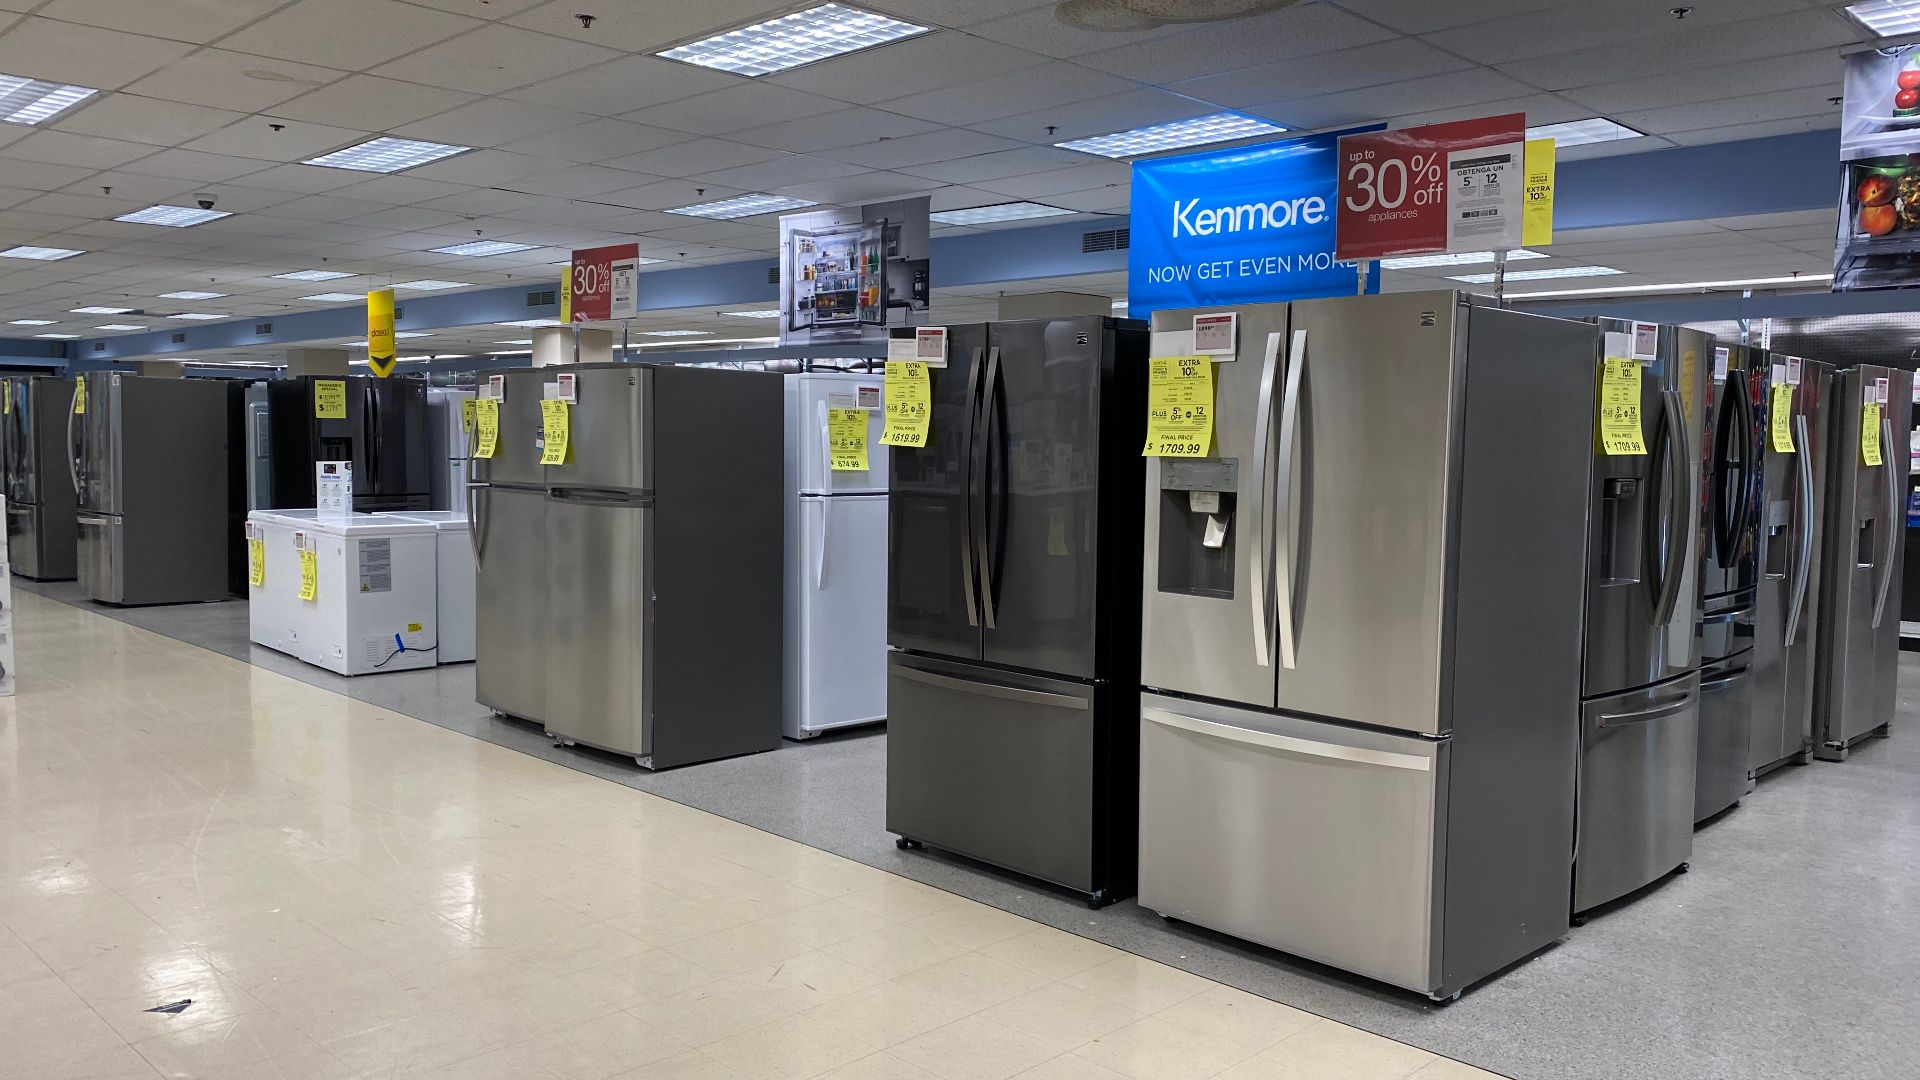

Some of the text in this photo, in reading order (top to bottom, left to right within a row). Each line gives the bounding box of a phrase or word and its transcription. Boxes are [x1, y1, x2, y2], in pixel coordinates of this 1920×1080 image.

[1350, 149, 1375, 162] up to
[1457, 167, 1491, 176] OBTENGA
[1485, 173, 1498, 184] 12
[1413, 182, 1444, 206] off
[1526, 185, 1551, 193] EXTRA
[1172, 196, 1326, 239] Kenmore
[1368, 209, 1418, 223] appliances
[1149, 264, 1192, 284] NOW
[1197, 260, 1234, 280] GET
[1239, 255, 1291, 277] EVEN
[598, 280, 611, 292] off
[1178, 359, 1201, 367] EXTRA
[1195, 406, 1204, 415] 12
[1630, 406, 1636, 414] 12
[891, 433, 921, 443] 1619.99
[1147, 442, 1200, 454] $ 1709.99
[1614, 441, 1641, 452] 1709.99
